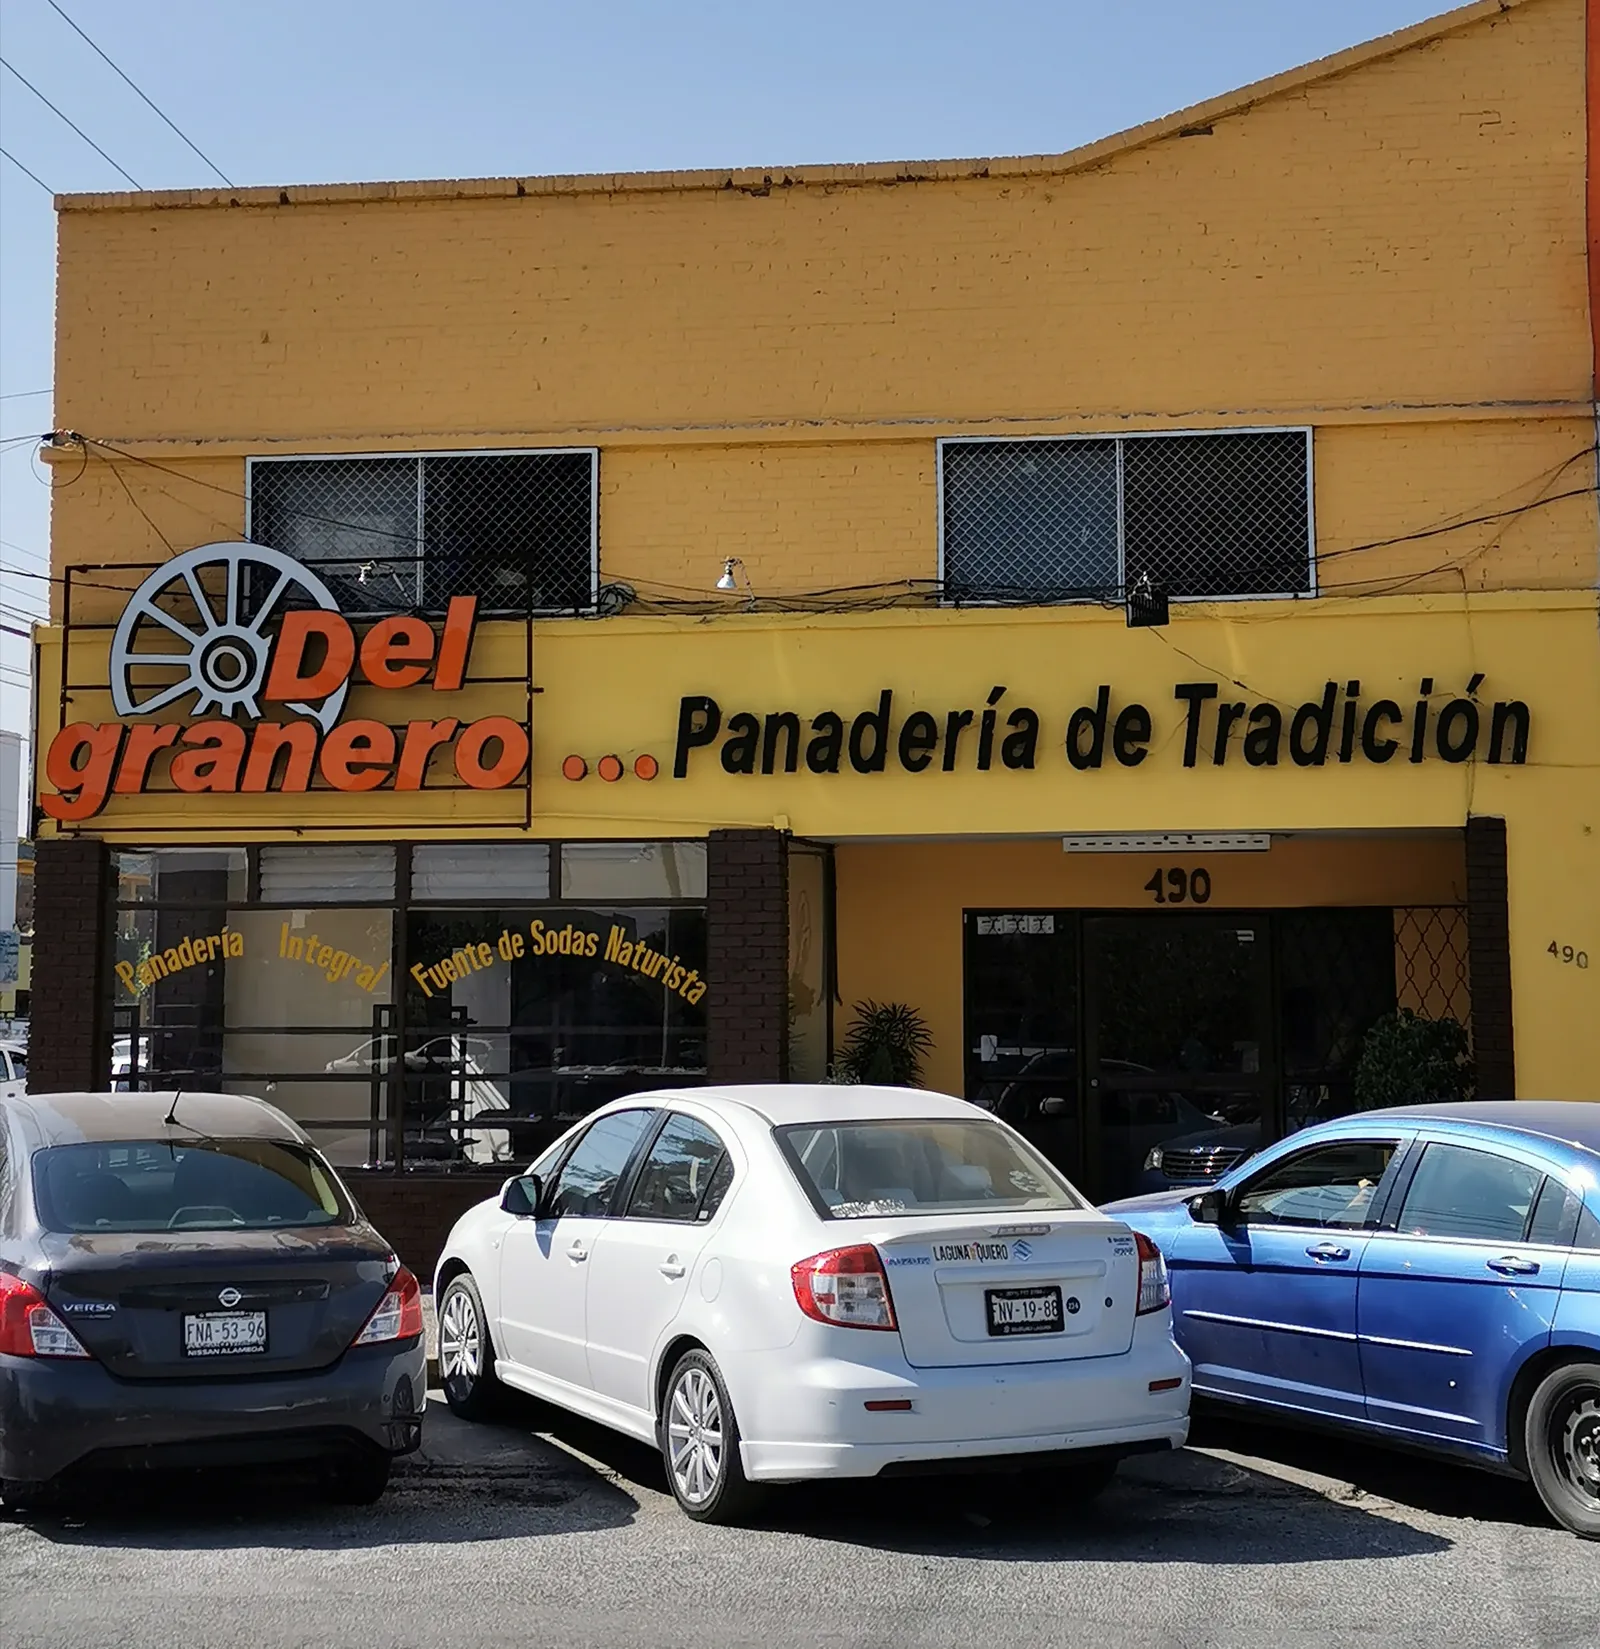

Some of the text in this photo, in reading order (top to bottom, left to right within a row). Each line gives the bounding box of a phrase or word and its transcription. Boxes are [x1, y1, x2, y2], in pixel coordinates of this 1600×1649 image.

[264, 595, 477, 700] Del
[673, 685, 1040, 778] Panadería
[1065, 685, 1152, 770] de
[1174, 673, 1531, 769] Tradición
[40, 715, 530, 821] granero
[1144, 867, 1211, 903] 490
[114, 921, 390, 996] Panadería Integral
[410, 919, 708, 1006] Fuente de Sodas Naturista
[1547, 940, 1589, 969] 490
[933, 1243, 1008, 1263] LAGUNA QUIERO
[62, 1303, 117, 1313] VERSA
[187, 1320, 265, 1342] FNA-53-96
[187, 1345, 265, 1357] NISSAN ALAMEDA
